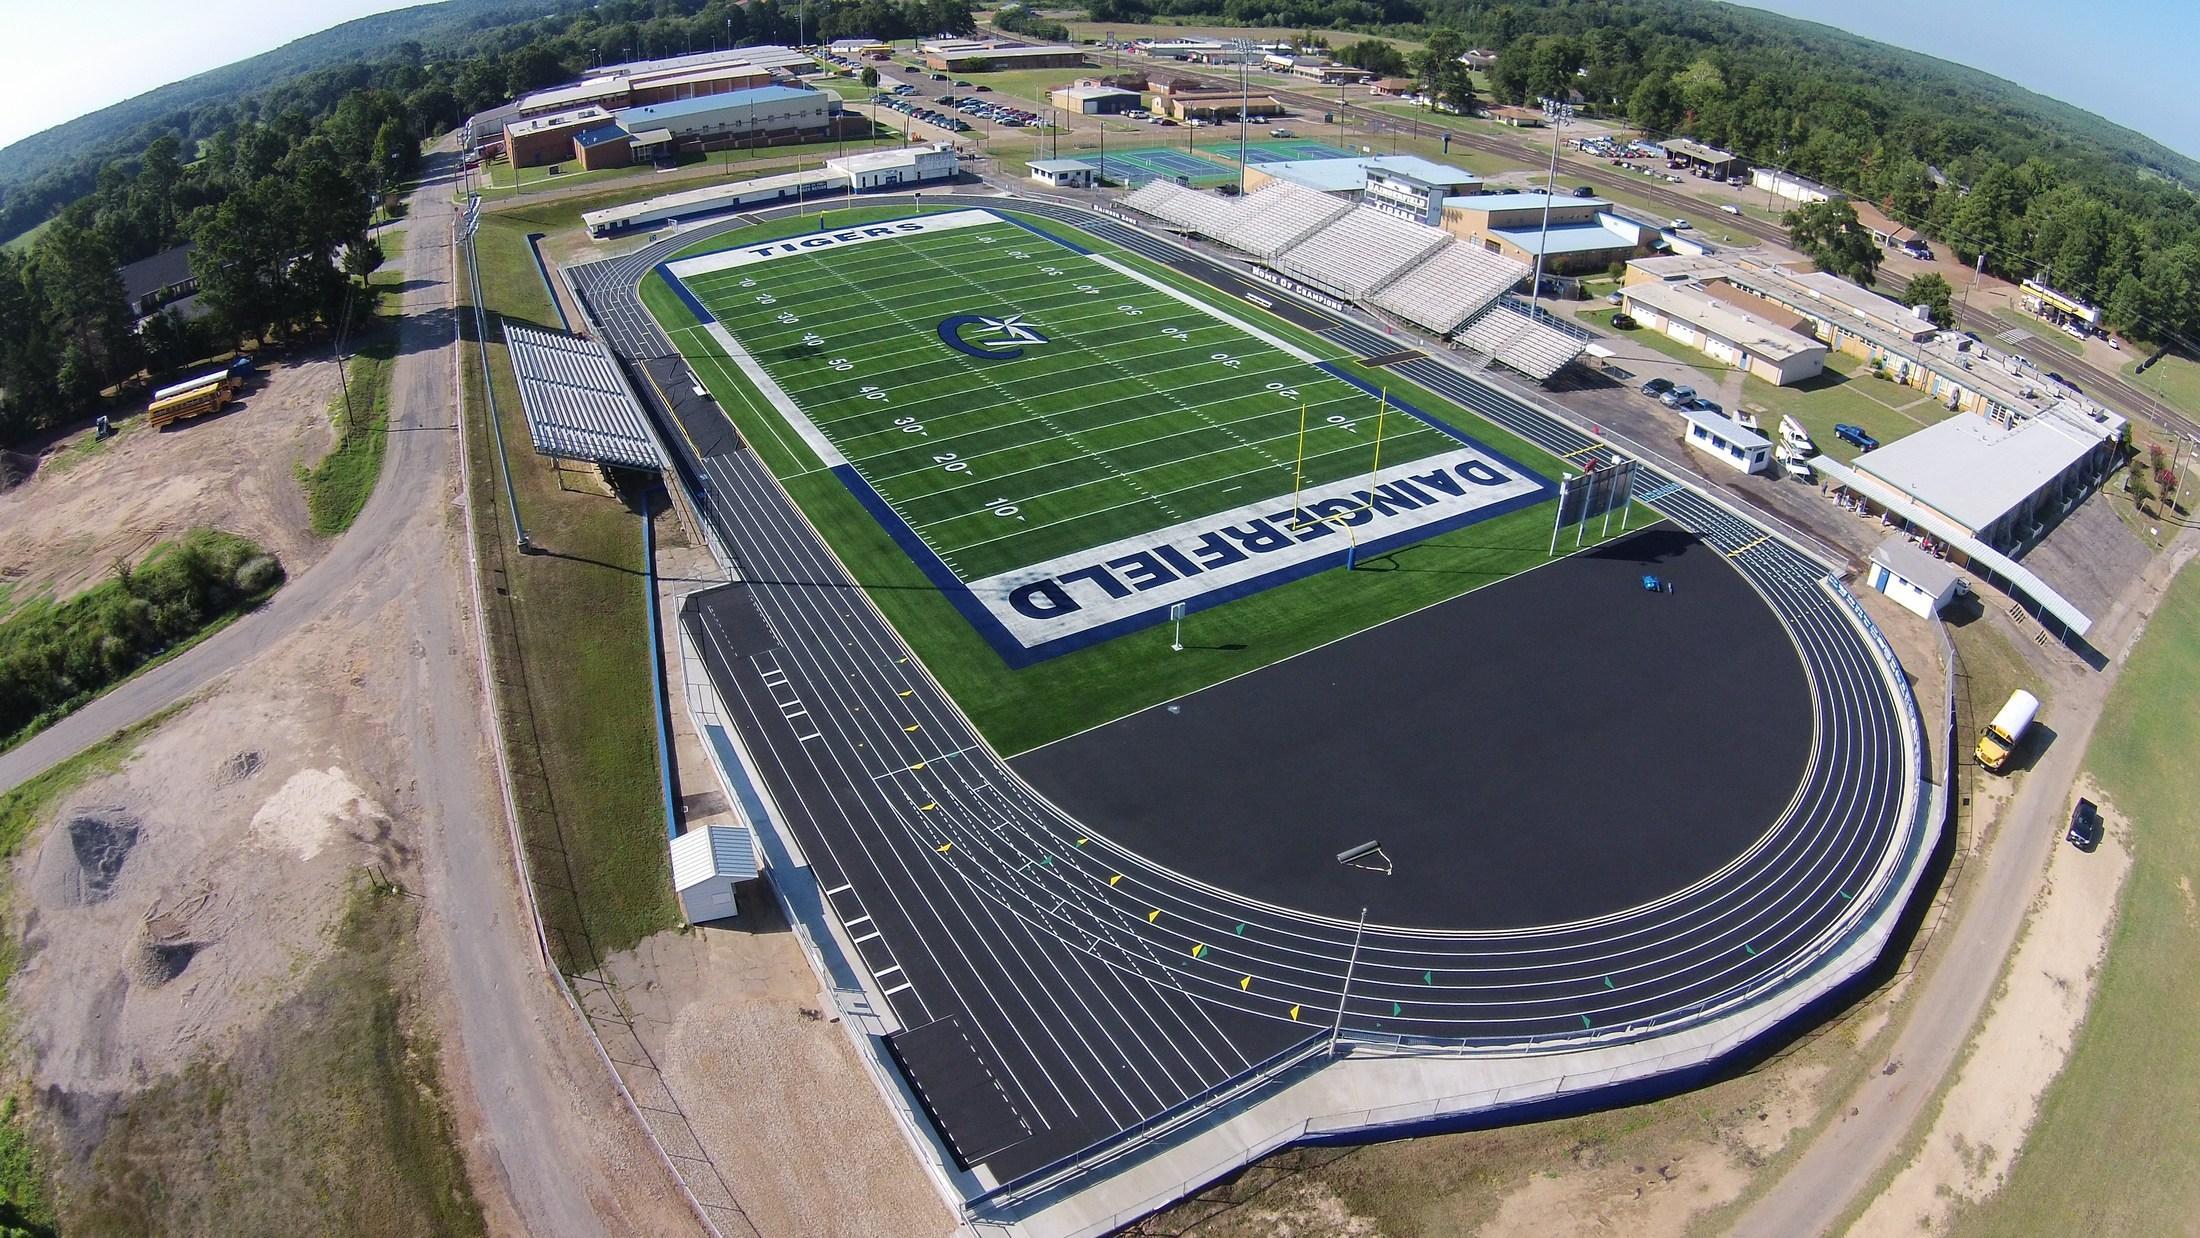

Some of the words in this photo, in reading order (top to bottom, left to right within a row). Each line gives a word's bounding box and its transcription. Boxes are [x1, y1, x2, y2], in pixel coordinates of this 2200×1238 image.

[748, 222, 924, 258] TIGERS
[1008, 251, 1031, 260] 20
[1040, 267, 1064, 277] 30
[1077, 285, 1100, 295] 40
[1252, 266, 1277, 283] HOME
[1296, 285, 1343, 312] CHAMPIONS
[755, 293, 777, 305] 20
[1117, 305, 1144, 316] 50
[777, 313, 800, 324] 30
[802, 334, 825, 346] 40
[1161, 327, 1188, 340] 40
[828, 358, 854, 372] 50
[1211, 353, 1241, 367] 30
[859, 386, 886, 400] 40
[1265, 382, 1300, 397] 20
[894, 416, 924, 433] 30
[1326, 415, 1357, 431] 10
[932, 453, 968, 472] 20
[984, 498, 1019, 517] 10
[1008, 459, 1512, 620] DAINGERFIELD
